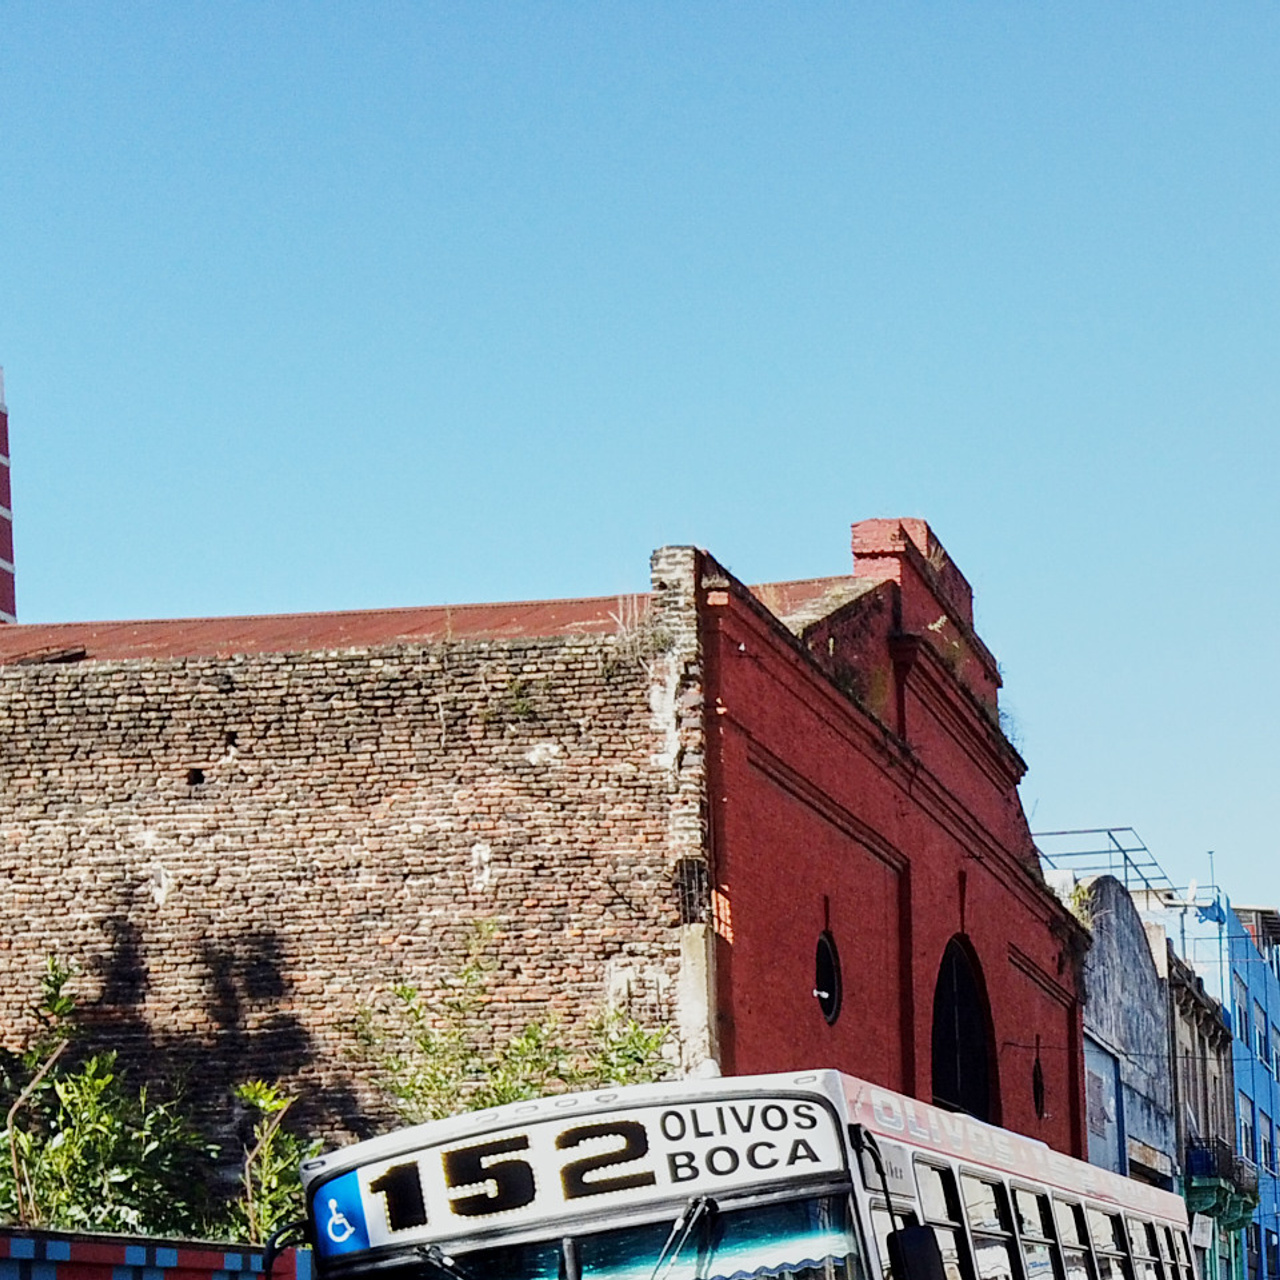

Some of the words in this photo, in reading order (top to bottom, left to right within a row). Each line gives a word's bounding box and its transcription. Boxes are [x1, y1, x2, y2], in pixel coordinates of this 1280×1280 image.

[660, 1104, 818, 1141] OLIVOS
[870, 1088, 1015, 1165] OLIVOS
[368, 1118, 657, 1234] 152
[666, 1139, 821, 1183] BOCA
